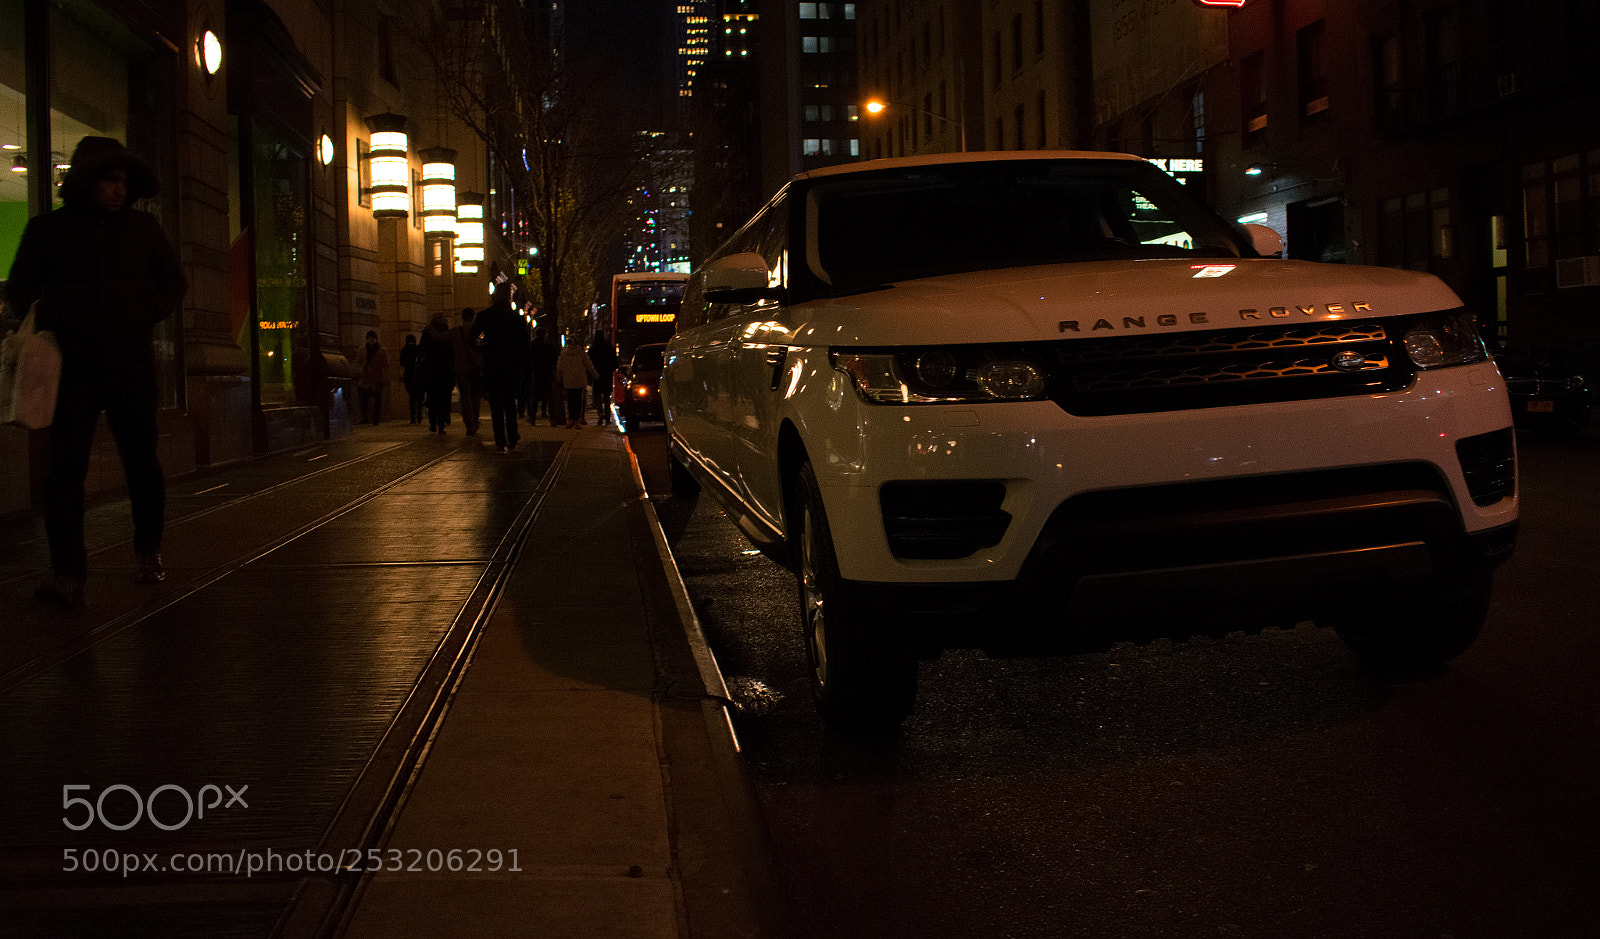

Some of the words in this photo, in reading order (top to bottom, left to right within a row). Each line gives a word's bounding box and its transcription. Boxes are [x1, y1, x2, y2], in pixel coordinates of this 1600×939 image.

[1169, 159, 1203, 172] HERE
[636, 313, 660, 323] UPTOWN
[660, 313, 676, 323] LOOP
[1058, 311, 1210, 333] RANGE
[1239, 301, 1372, 321] ROVER
